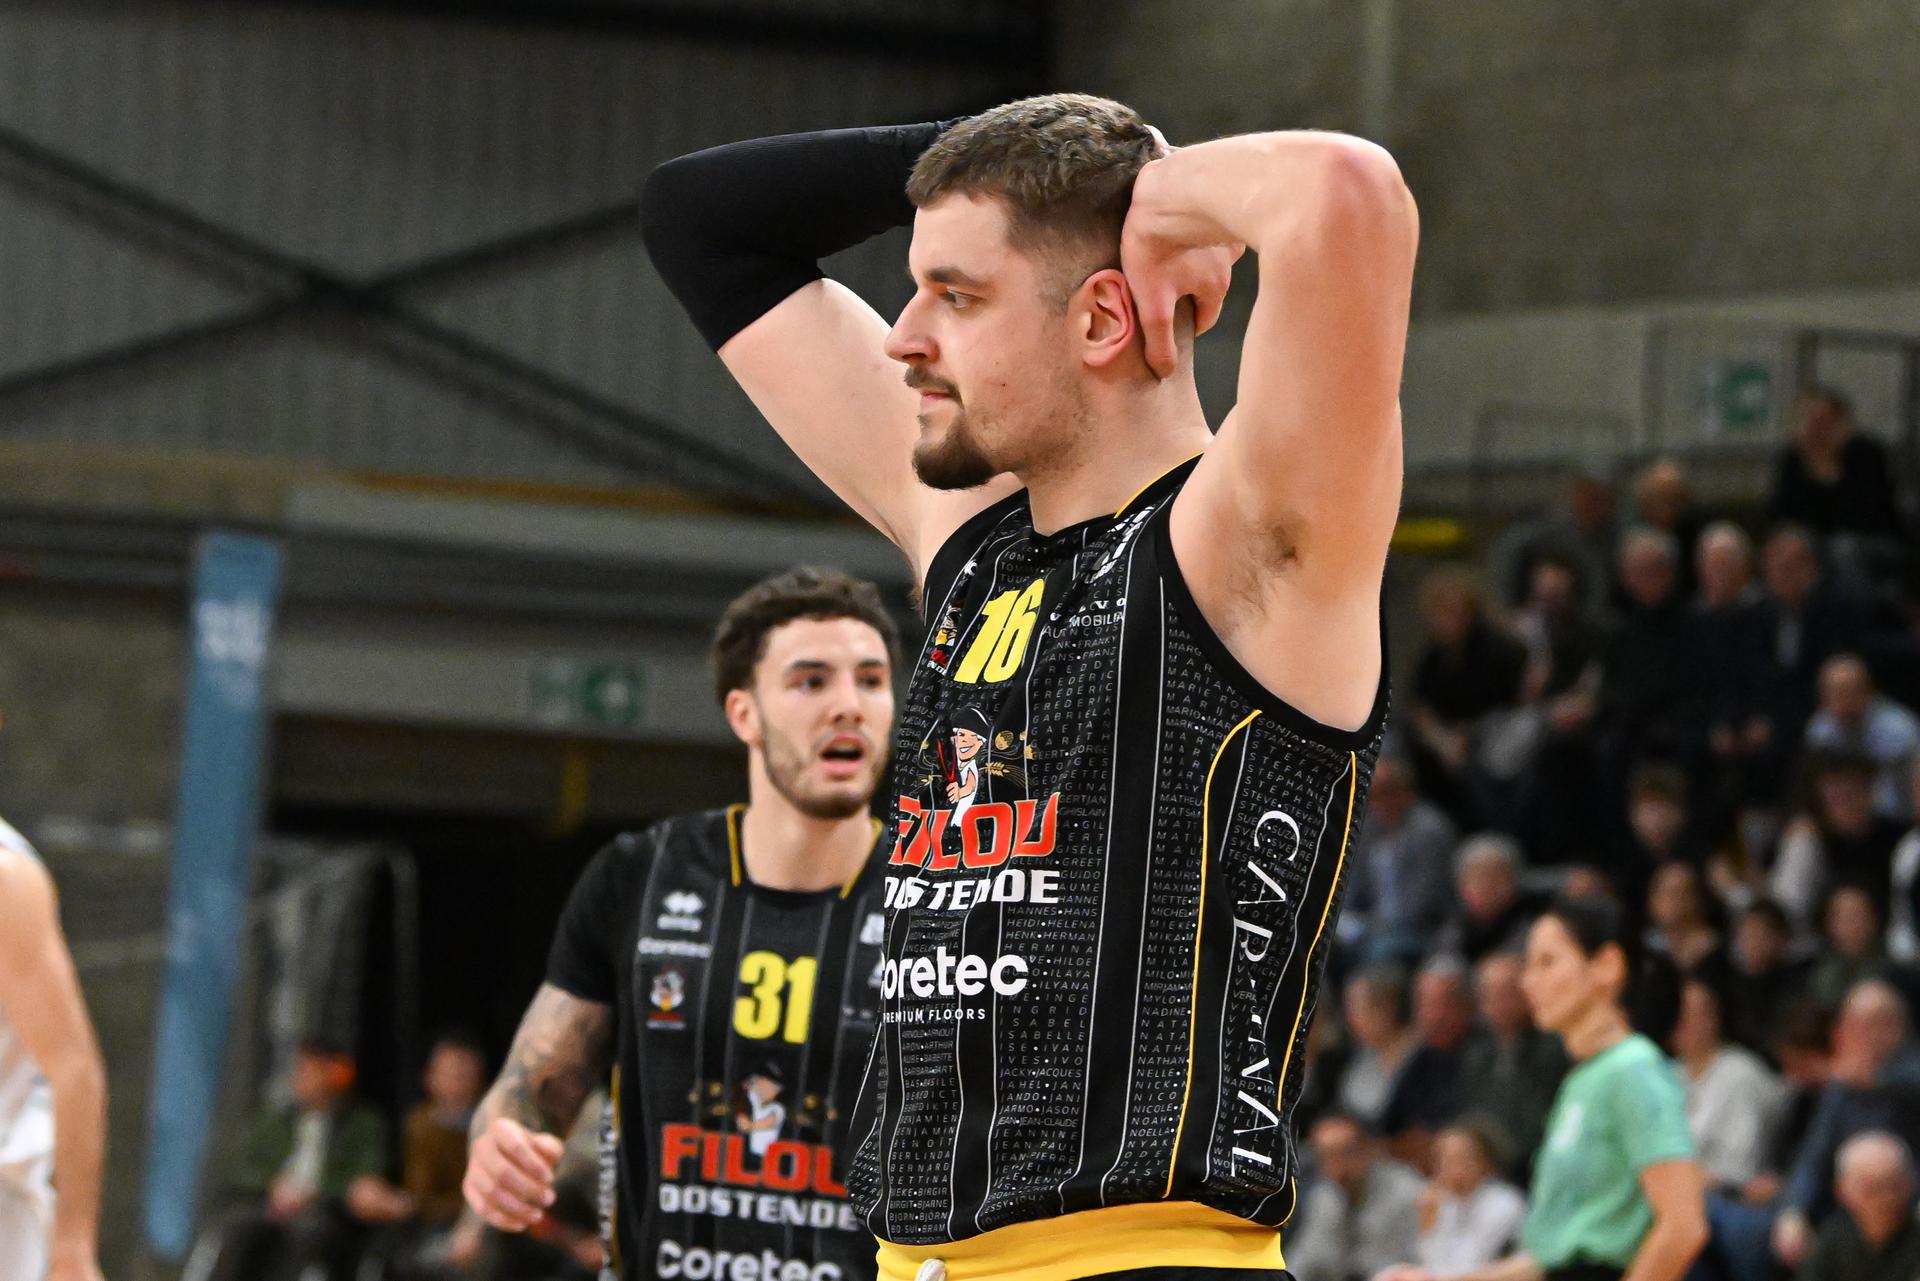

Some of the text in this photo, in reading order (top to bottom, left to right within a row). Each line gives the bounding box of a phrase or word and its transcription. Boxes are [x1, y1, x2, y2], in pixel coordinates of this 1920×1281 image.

[954, 577, 1046, 684] 16
[1007, 906, 1098, 918] HANNES HANS
[1006, 918, 1096, 930] HEIDI HELENA
[1005, 931, 1037, 941] HENK
[1003, 943, 1093, 954] HERMINA
[733, 949, 818, 1045] 31
[929, 1009, 986, 1021] FLOORS
[1000, 1018, 1086, 1029] ISABEL
[1000, 1030, 1085, 1041] ISABELLE
[1043, 1043, 1084, 1053] IVAN
[1053, 1056, 1083, 1066] IVO
[1052, 1080, 1082, 1091] JAN
